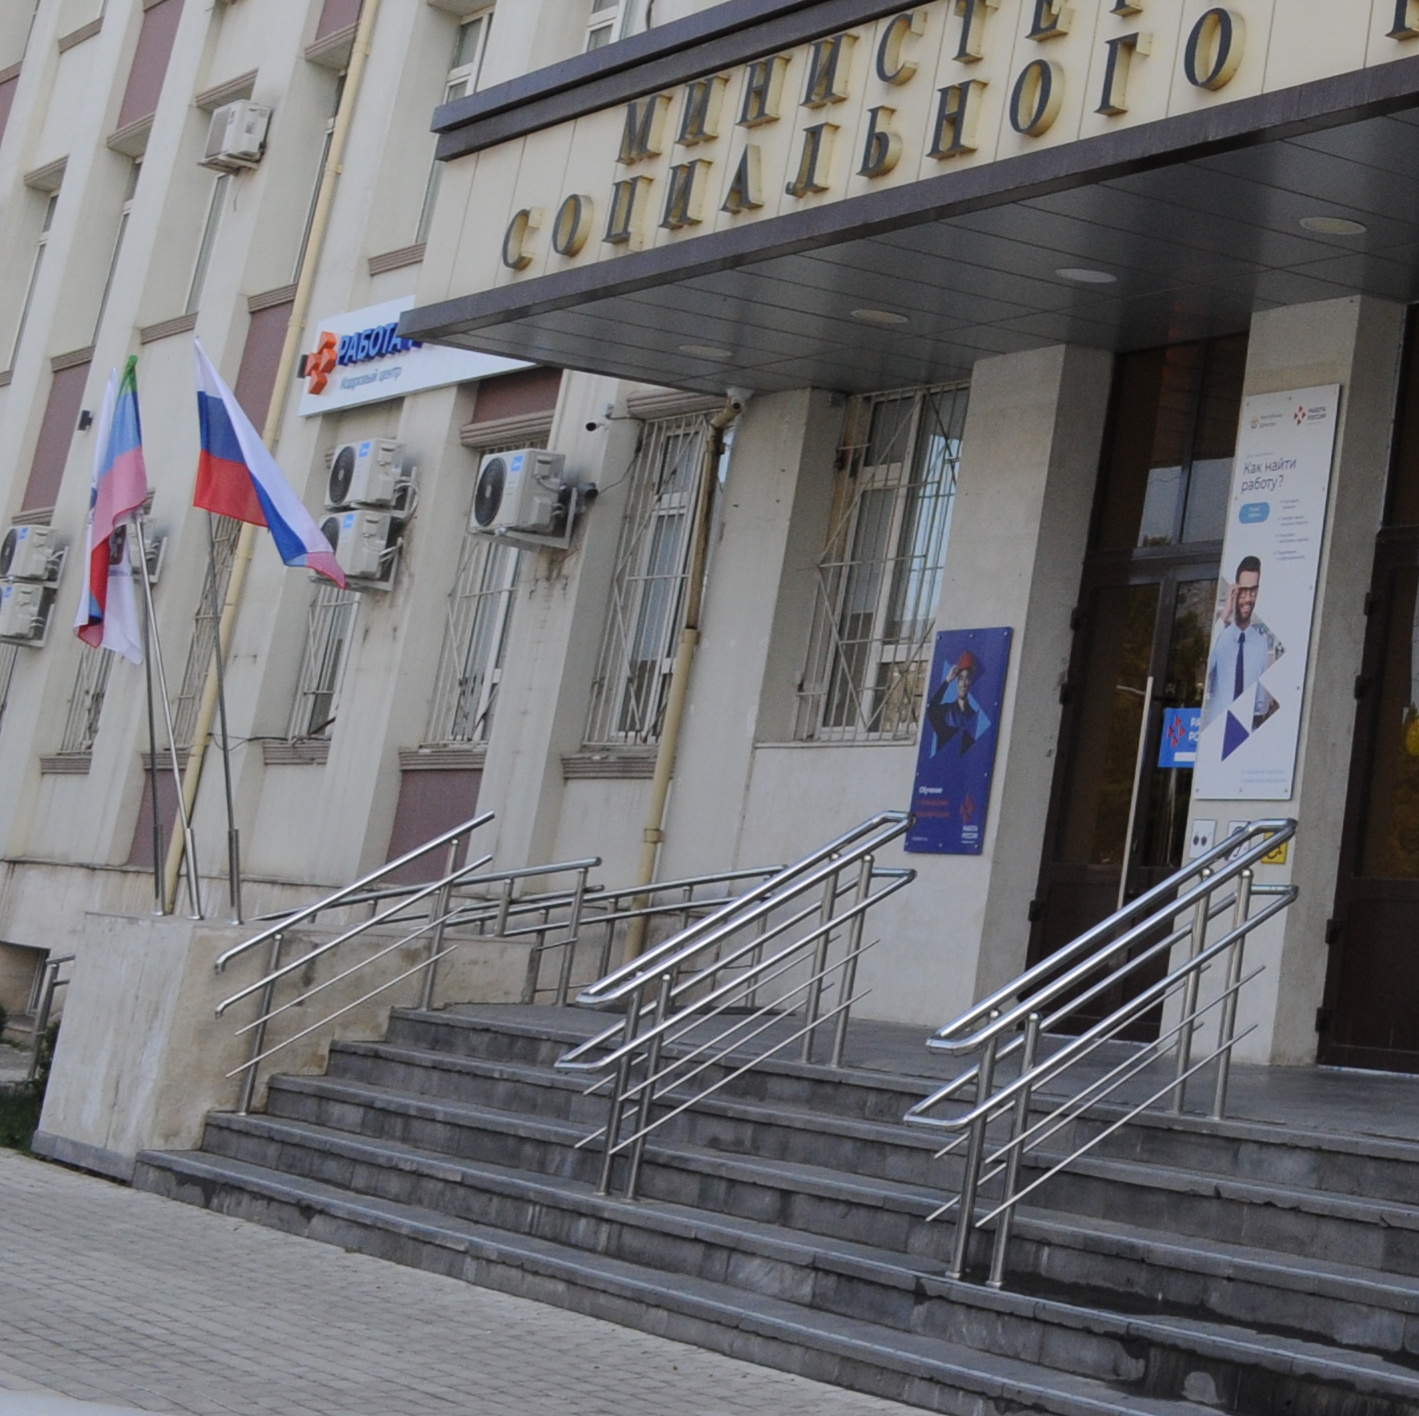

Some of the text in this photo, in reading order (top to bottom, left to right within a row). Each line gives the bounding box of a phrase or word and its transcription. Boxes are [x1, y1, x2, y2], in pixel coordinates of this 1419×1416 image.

[502, 6, 1246, 271] СОЦИАЛЬНОГО
[1243, 457, 1297, 475] Как найти
[1240, 474, 1284, 494] работу?
